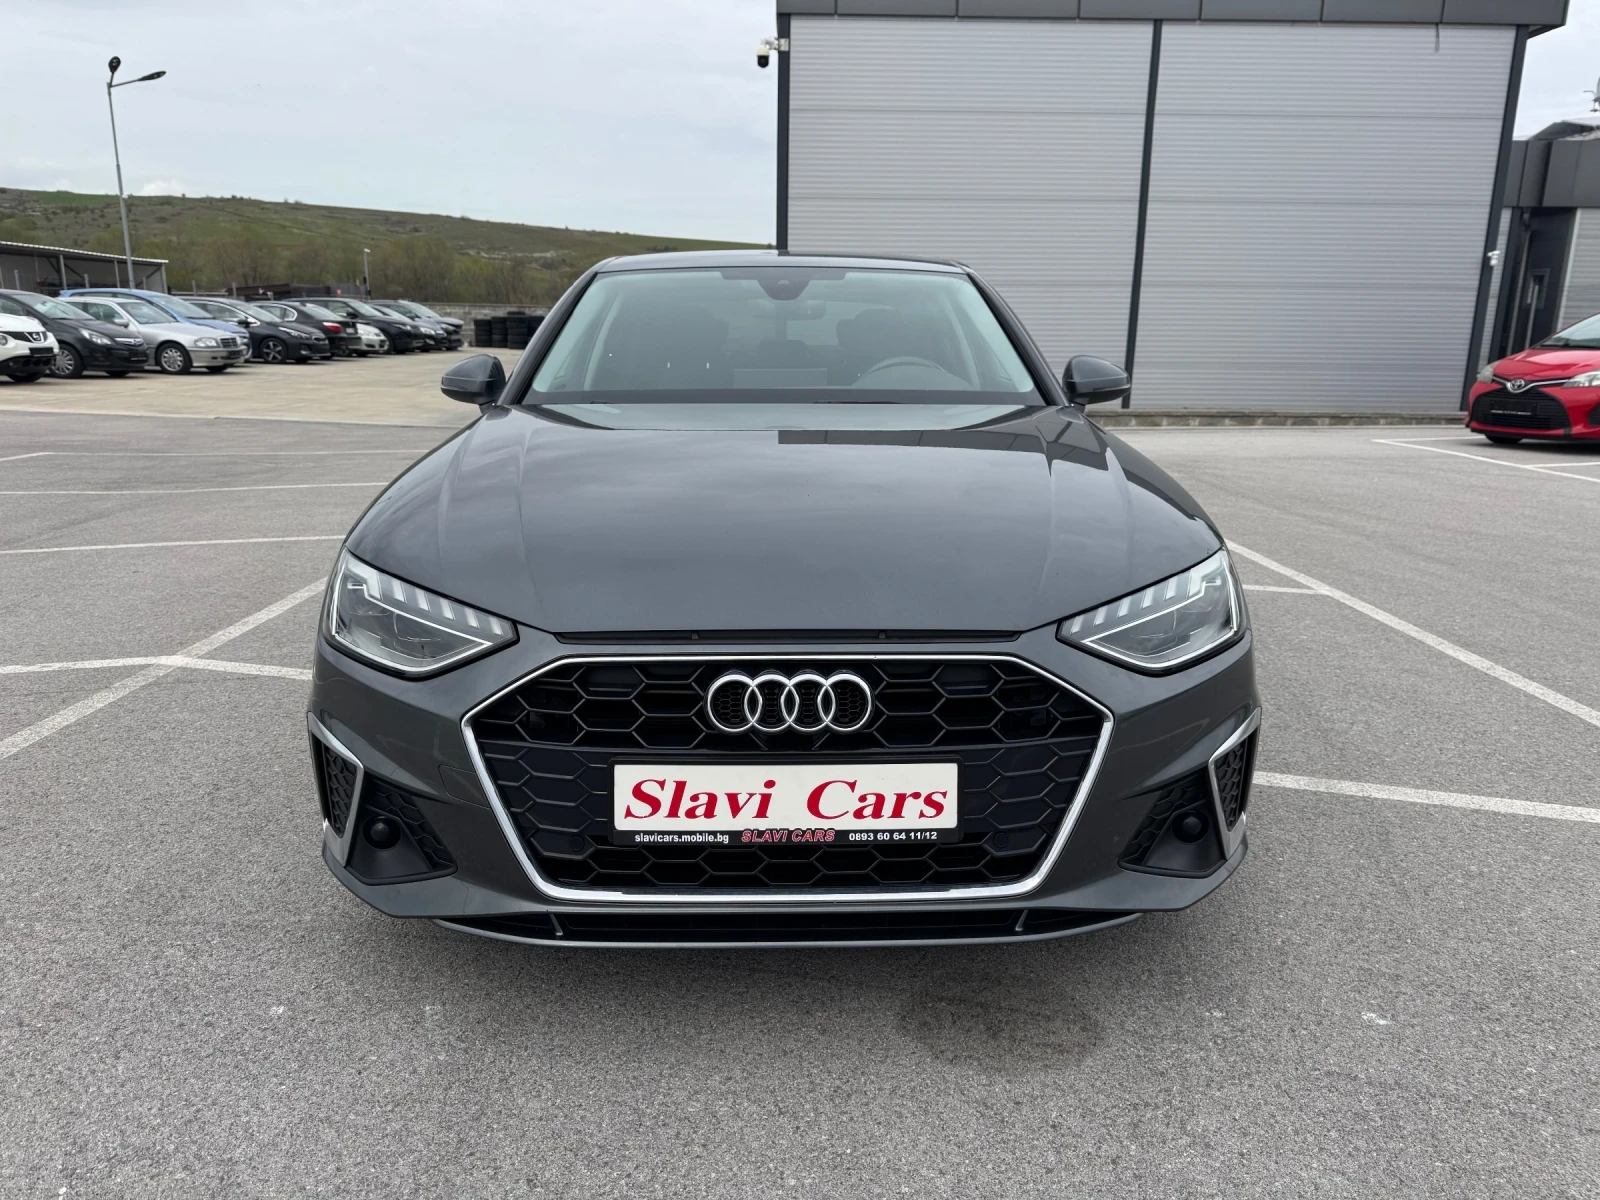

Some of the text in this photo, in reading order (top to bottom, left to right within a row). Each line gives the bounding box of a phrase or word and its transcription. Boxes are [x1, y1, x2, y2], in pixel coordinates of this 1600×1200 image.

[624, 779, 948, 820] Slavi Cars
[634, 832, 729, 844] slavicars.mobile.bg
[741, 829, 835, 842] SLAVI CARS
[848, 831, 938, 841] 0893 60 64 11/12
